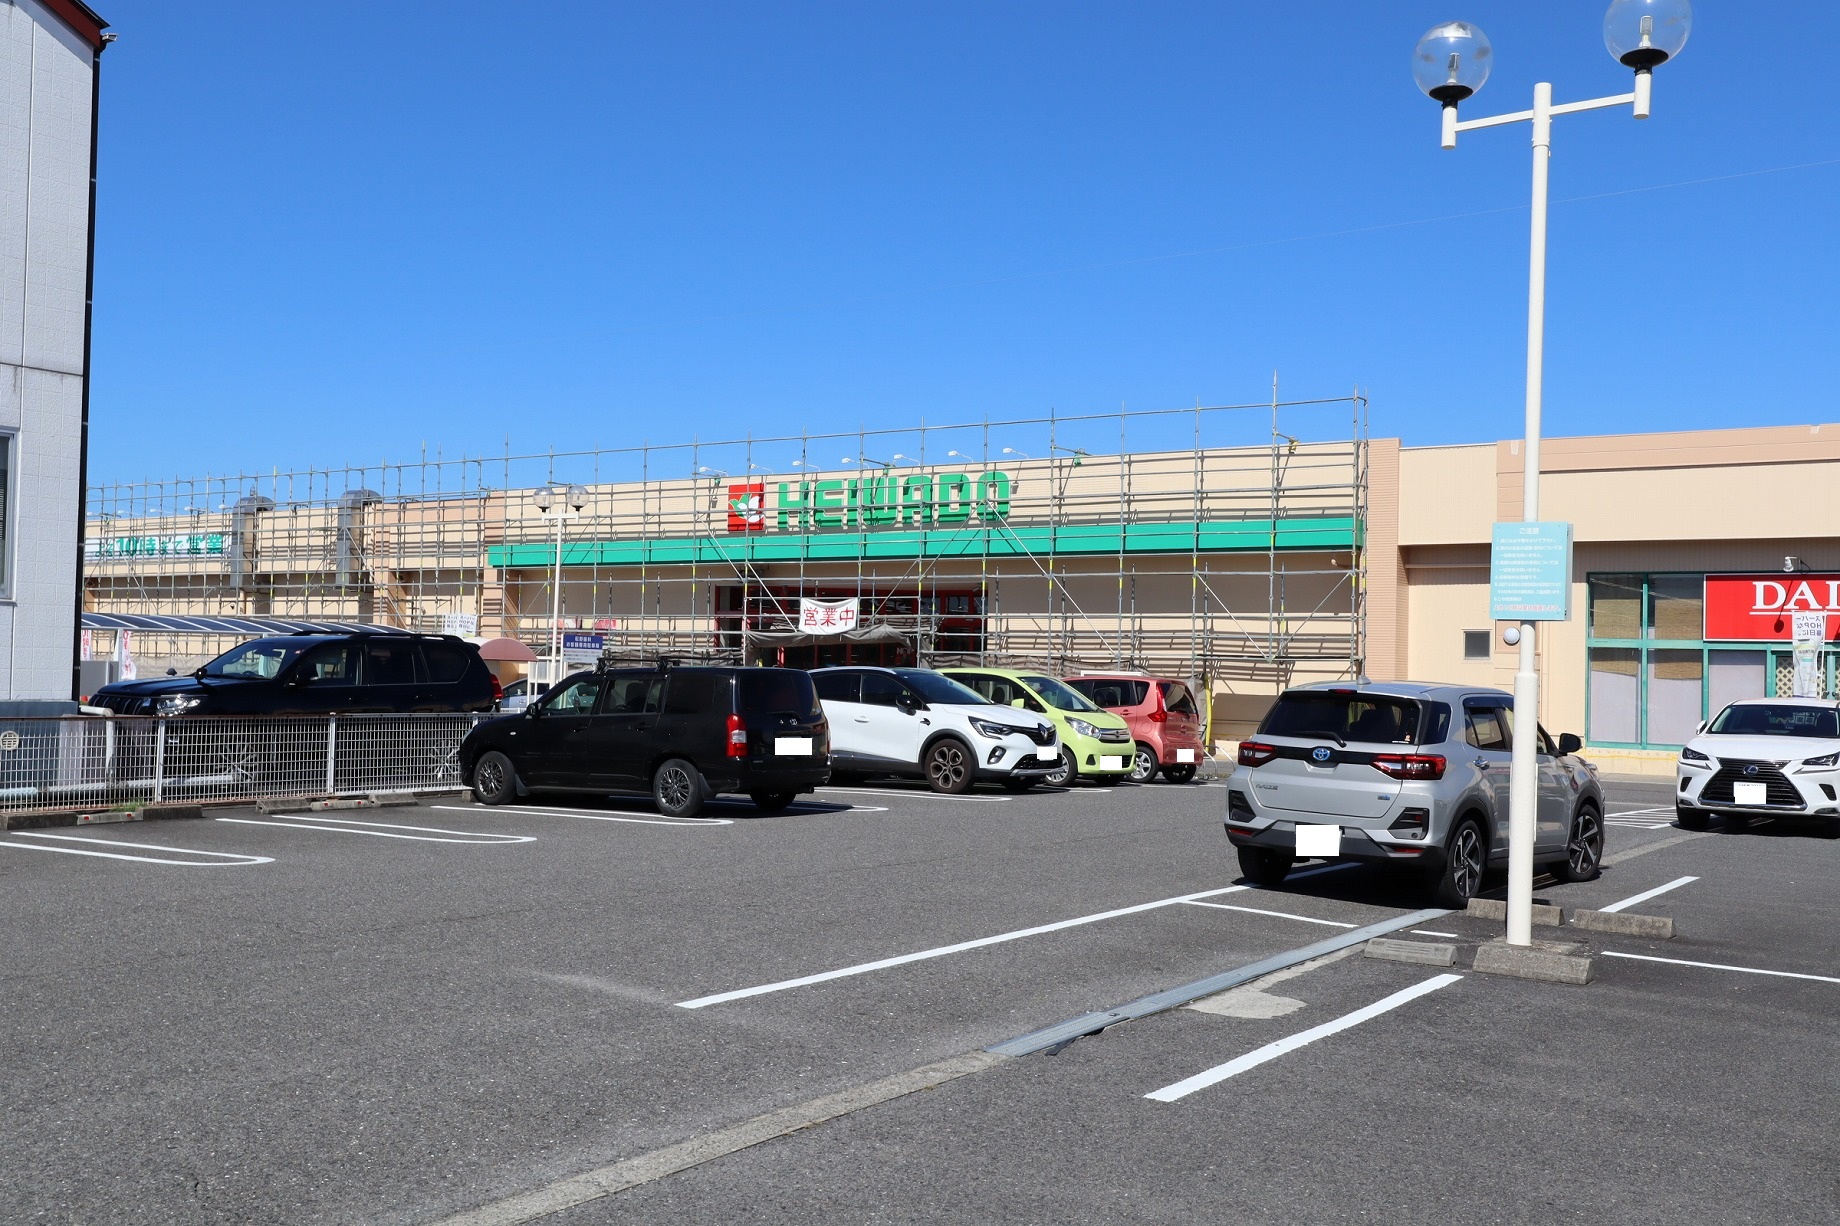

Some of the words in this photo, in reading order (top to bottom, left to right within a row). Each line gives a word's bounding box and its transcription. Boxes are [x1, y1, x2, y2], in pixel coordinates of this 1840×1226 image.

[777, 471, 1010, 529] HEIWADO
[803, 606, 855, 627] 営業中
